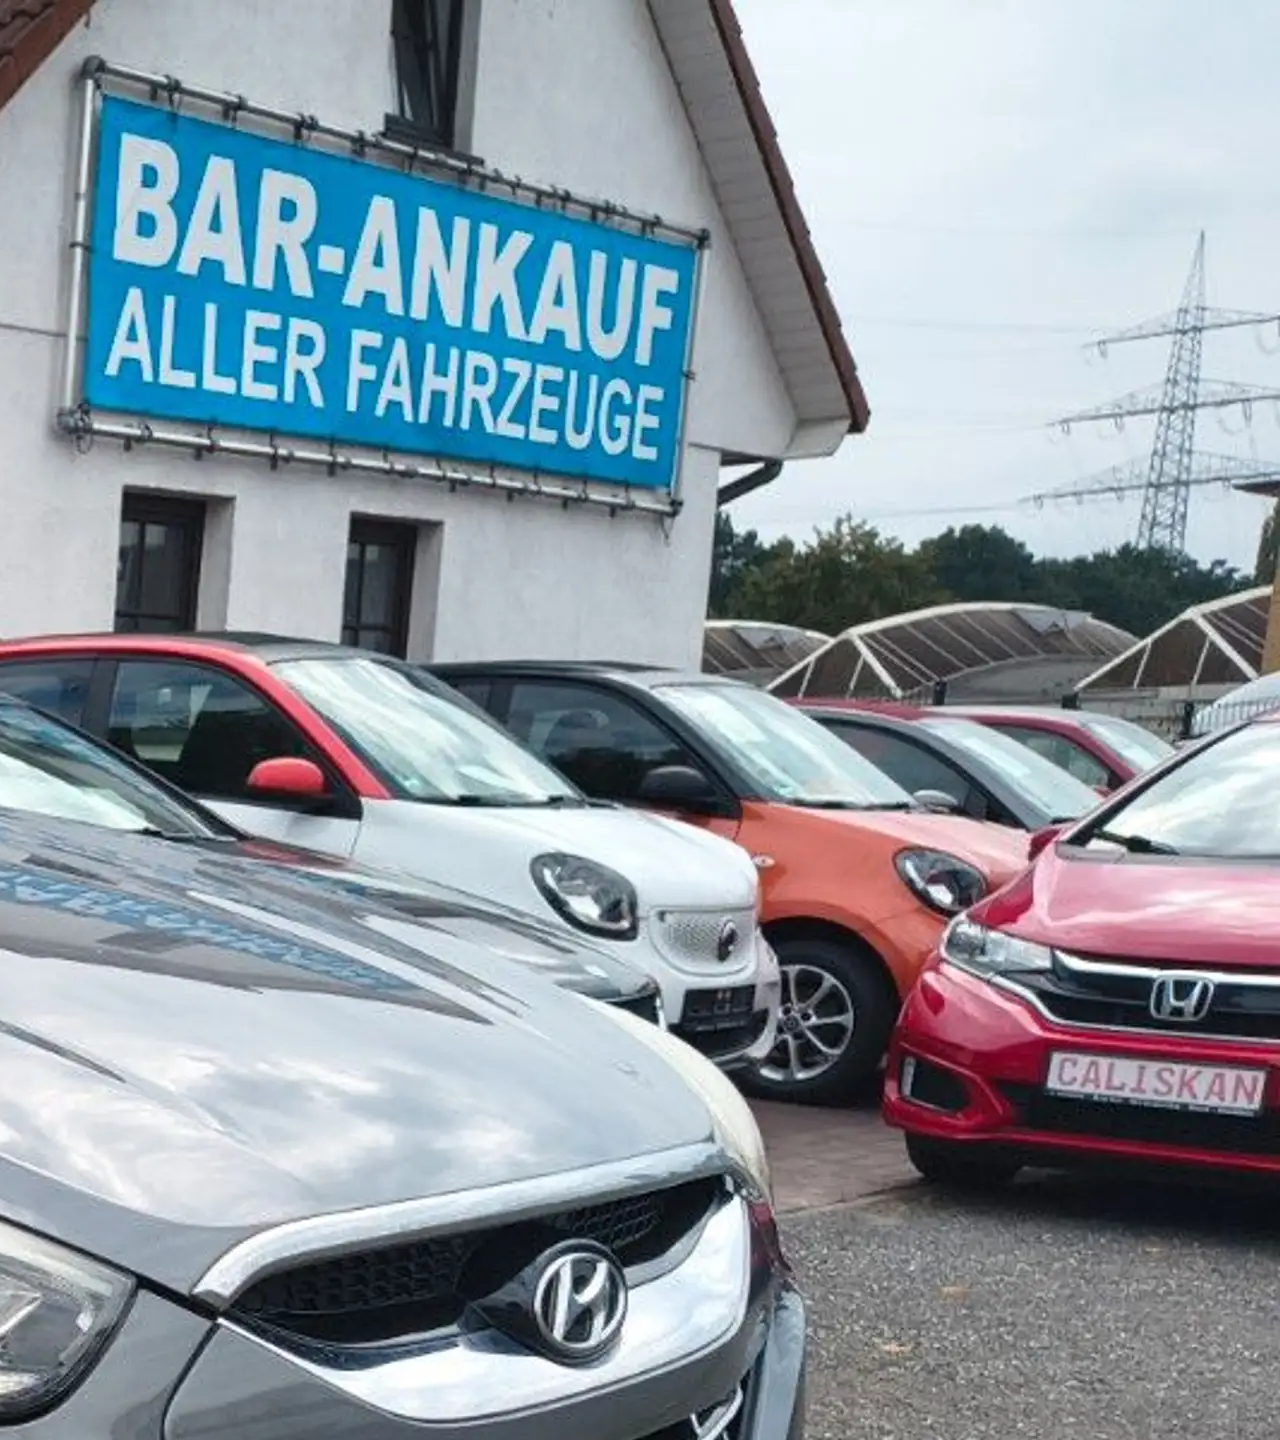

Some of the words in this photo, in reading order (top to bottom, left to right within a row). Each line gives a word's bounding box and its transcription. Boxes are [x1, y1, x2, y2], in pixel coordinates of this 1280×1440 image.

[113, 131, 680, 367] BAR-ANKAUF
[105, 287, 327, 410] ALLER
[345, 329, 666, 461] FAHRZEUGE
[1057, 1056, 1260, 1105] CALISKAN
